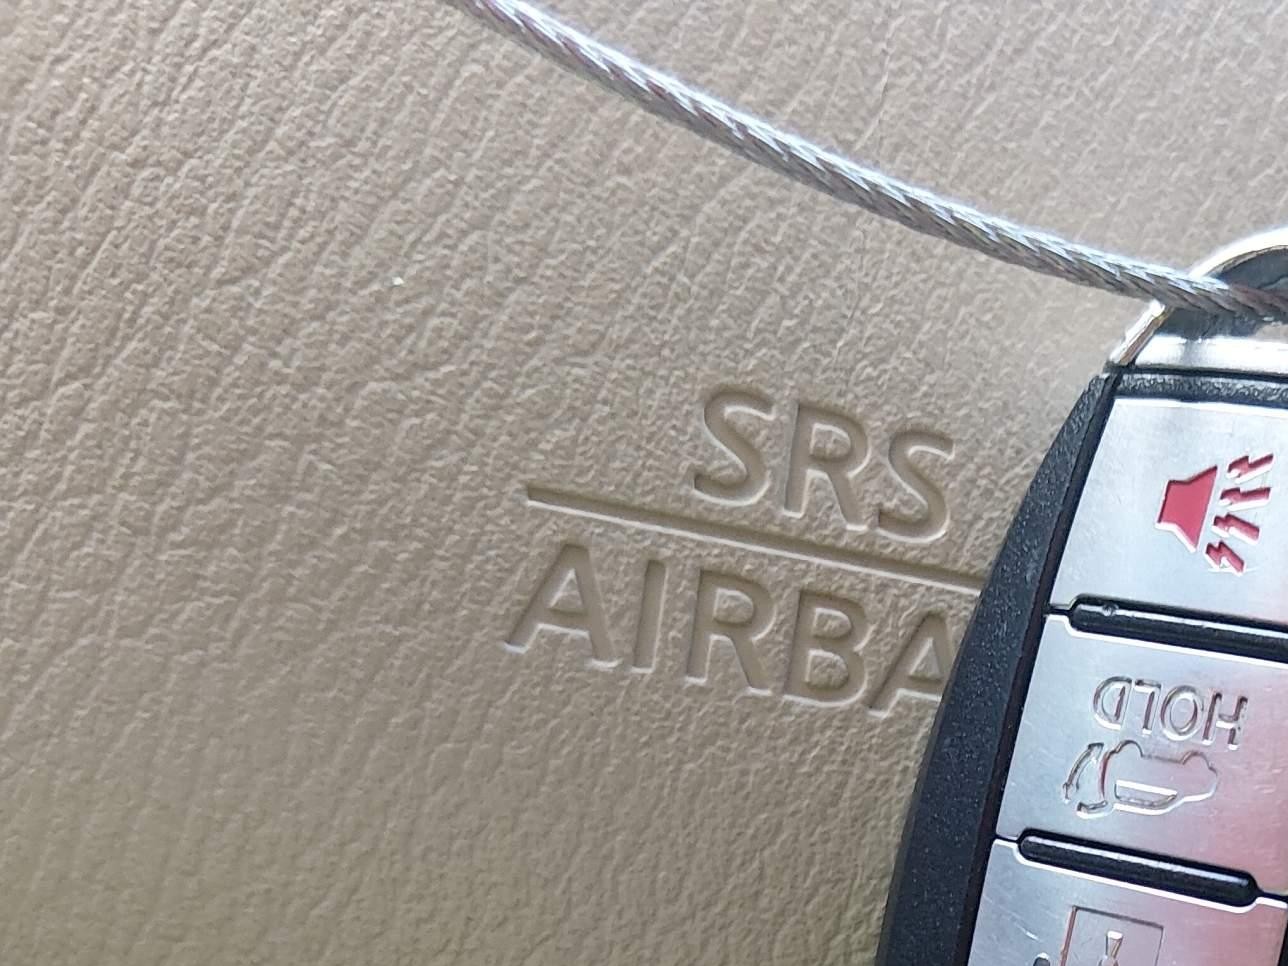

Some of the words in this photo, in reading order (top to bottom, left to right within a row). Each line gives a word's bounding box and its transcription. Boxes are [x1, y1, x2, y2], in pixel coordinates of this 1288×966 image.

[692, 383, 955, 544] SRS
[502, 543, 960, 717] AIRBA
[1093, 675, 1249, 749] HOLD
